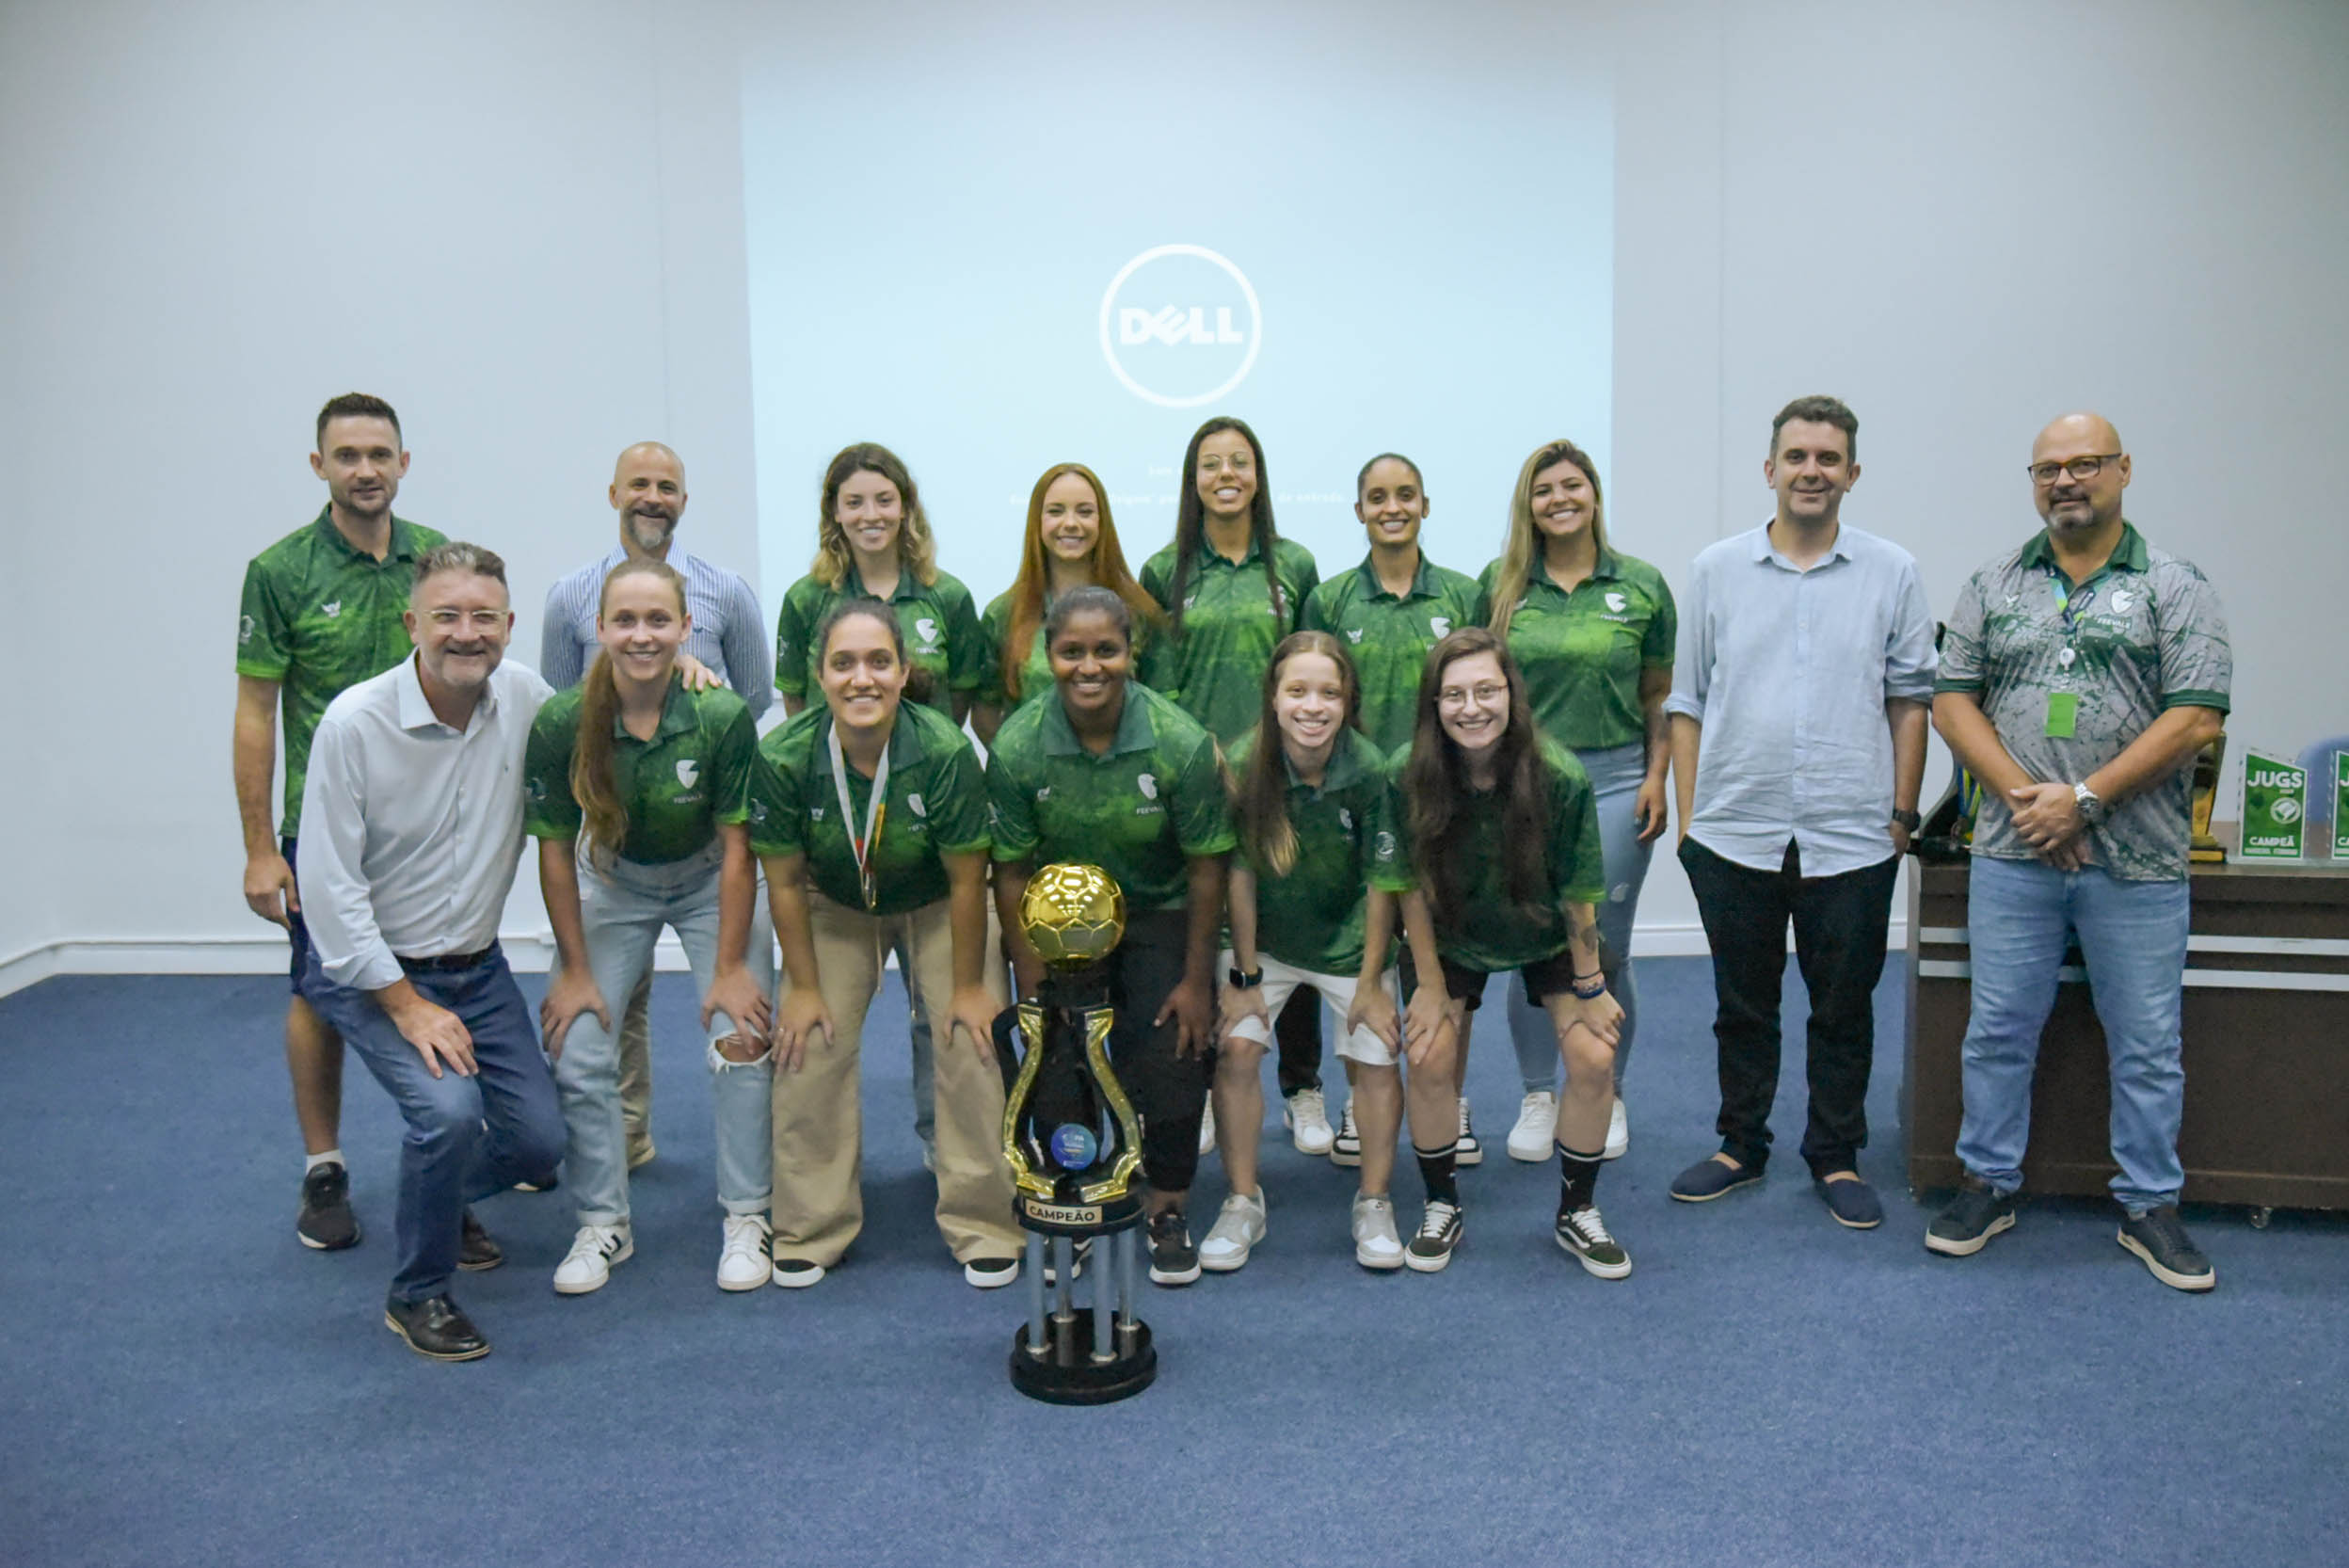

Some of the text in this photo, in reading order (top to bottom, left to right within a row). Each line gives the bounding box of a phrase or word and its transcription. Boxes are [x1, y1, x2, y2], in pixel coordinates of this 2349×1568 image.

[1118, 303, 1244, 347] DELL
[2246, 770, 2304, 789] JUGS
[2248, 835, 2295, 847] CAMPEÃ
[1029, 1206, 1095, 1222] CAMPEÃO
